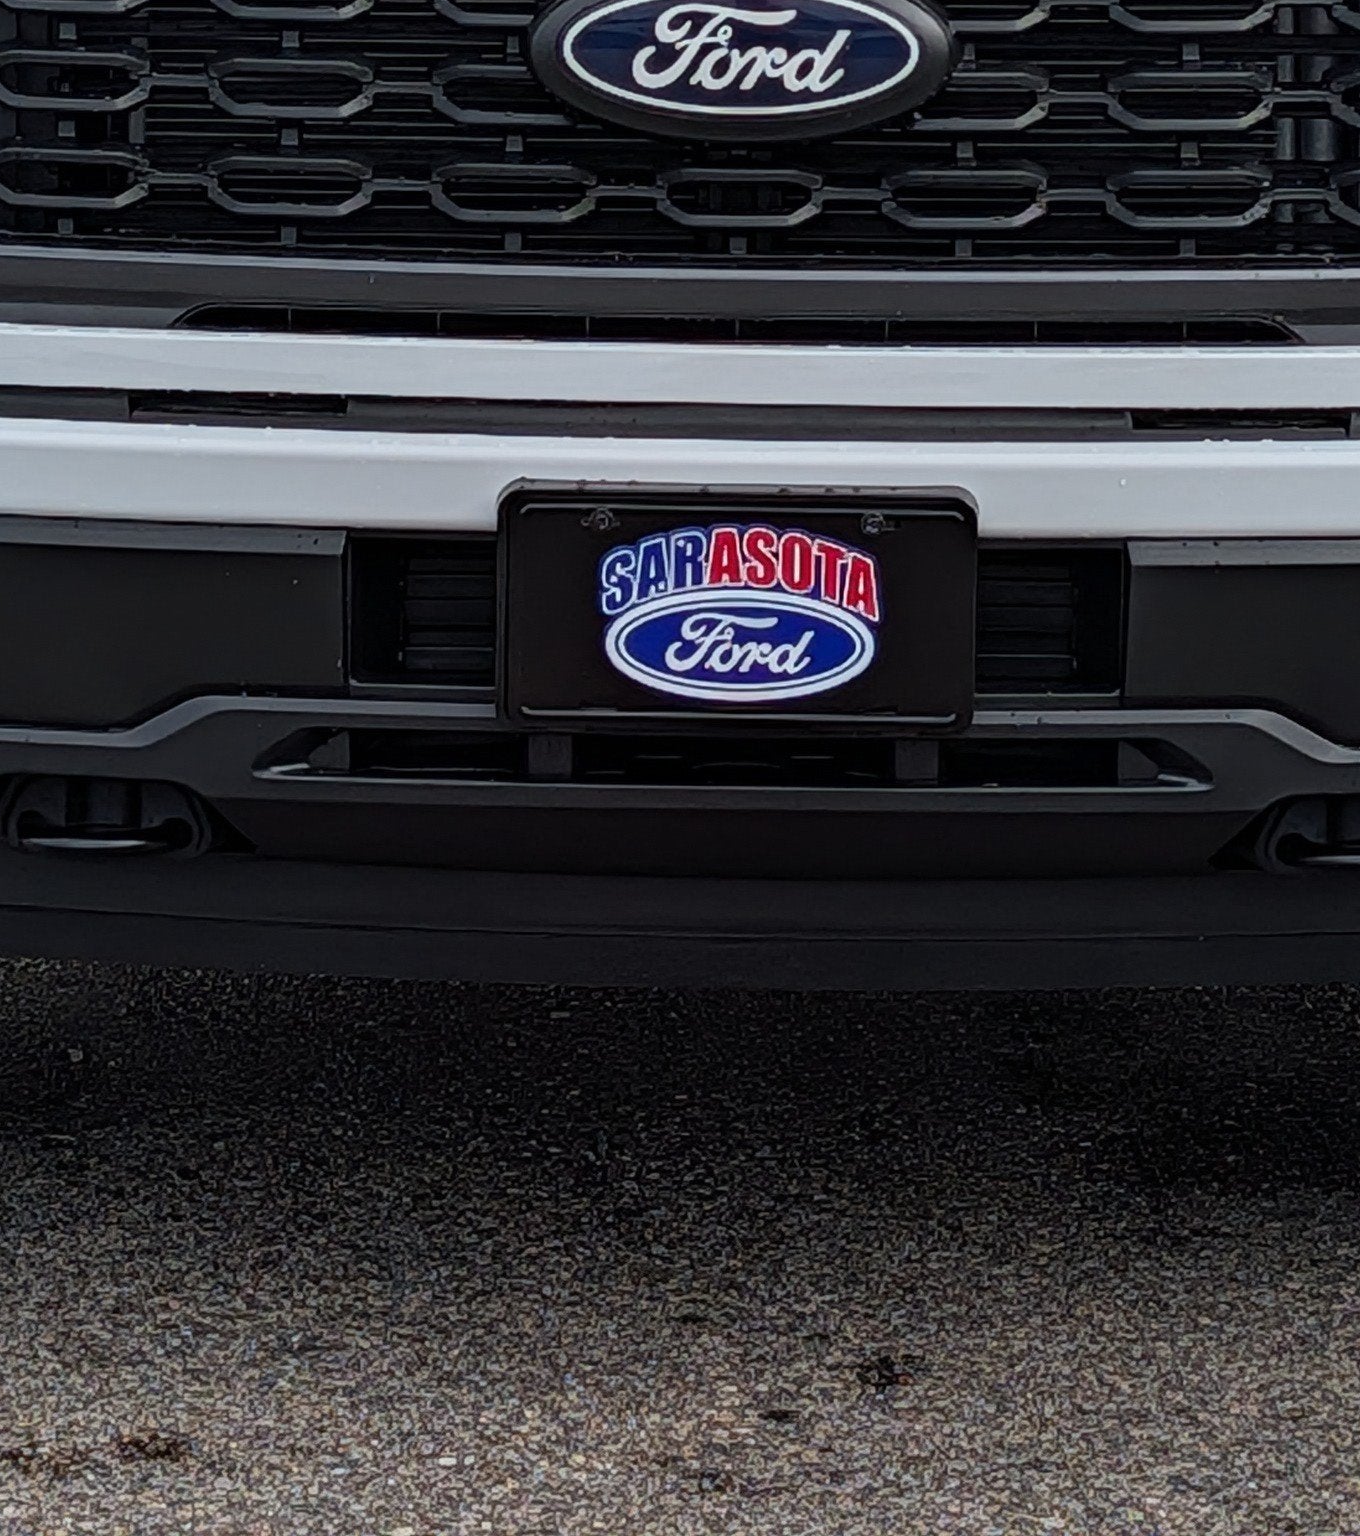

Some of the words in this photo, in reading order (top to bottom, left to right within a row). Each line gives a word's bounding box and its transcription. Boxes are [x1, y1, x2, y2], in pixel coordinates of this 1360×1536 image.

[633, 4, 851, 92] Ford
[601, 527, 880, 622] SARASOTA
[665, 612, 815, 674] Ford
